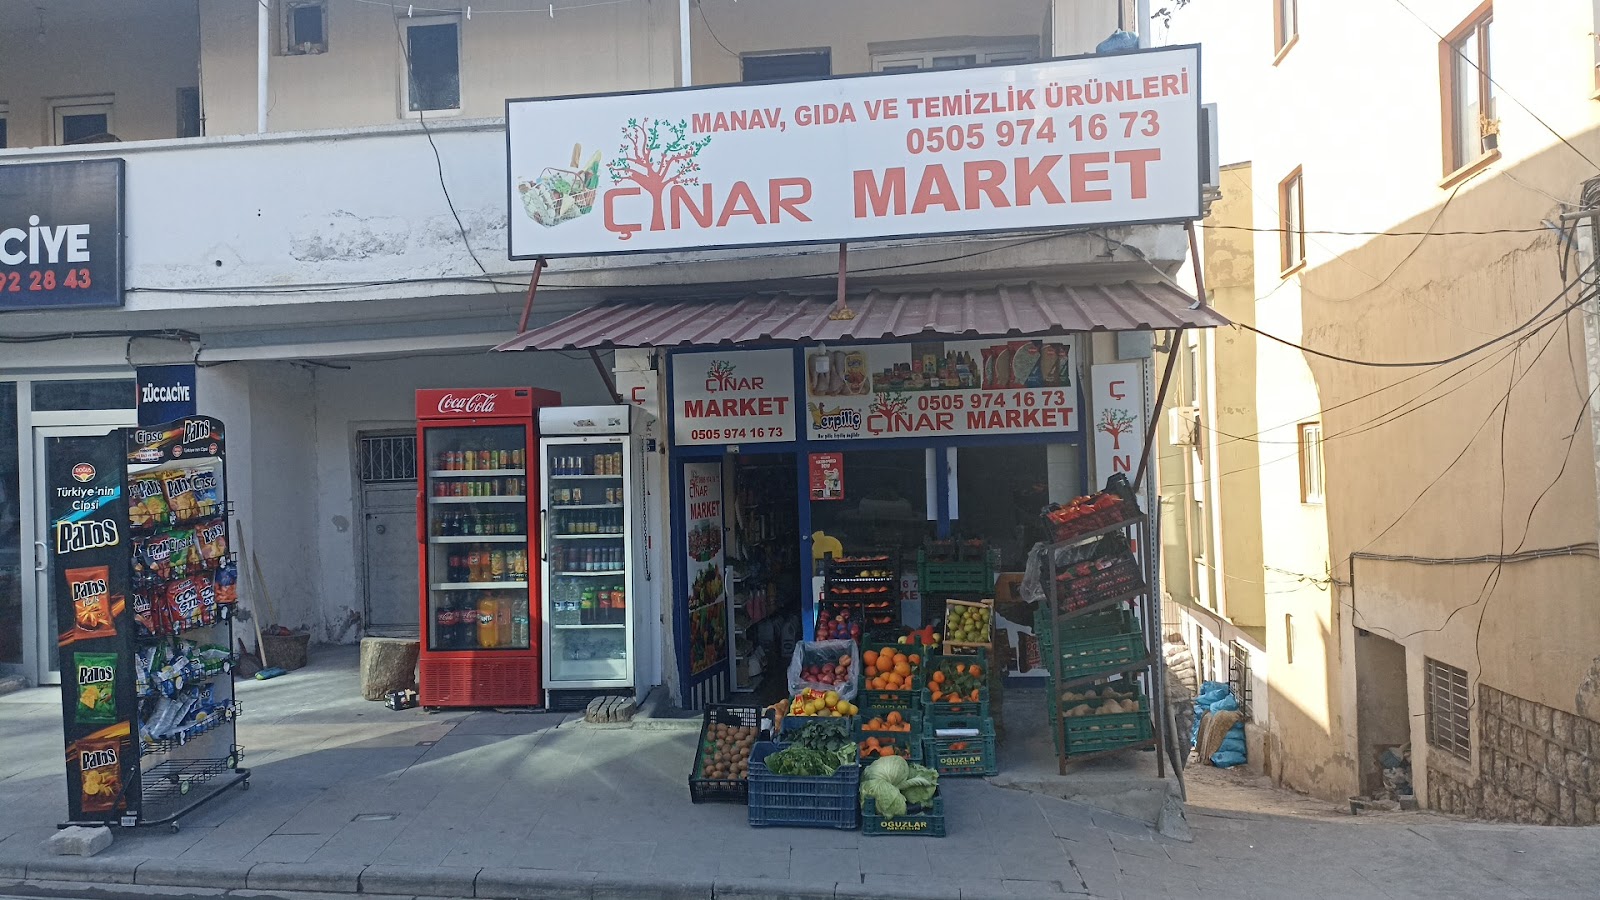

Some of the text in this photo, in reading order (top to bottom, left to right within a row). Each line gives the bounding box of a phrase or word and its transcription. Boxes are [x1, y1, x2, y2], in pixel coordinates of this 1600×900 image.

[692, 67, 1189, 133] MANAV, GIDA VE TEMİZLİK ÜRÜNLERİ
[906, 109, 1160, 155] 0505 974 16 73
[853, 147, 1161, 219] MARKET
[0, 214, 90, 266] CİYE
[29, 269, 56, 291] 28
[63, 268, 91, 289] 43
[437, 393, 498, 413] Coca-Cola
[684, 396, 789, 418] MARKET
[917, 389, 1066, 411] 0505 974 16 73
[966, 406, 1074, 430] MARKET
[691, 426, 783, 440] 0505 974 16 73
[57, 486, 114, 498] Türkiye'nin
[72, 500, 100, 511] Cipsi
[690, 500, 720, 520] MARKET
